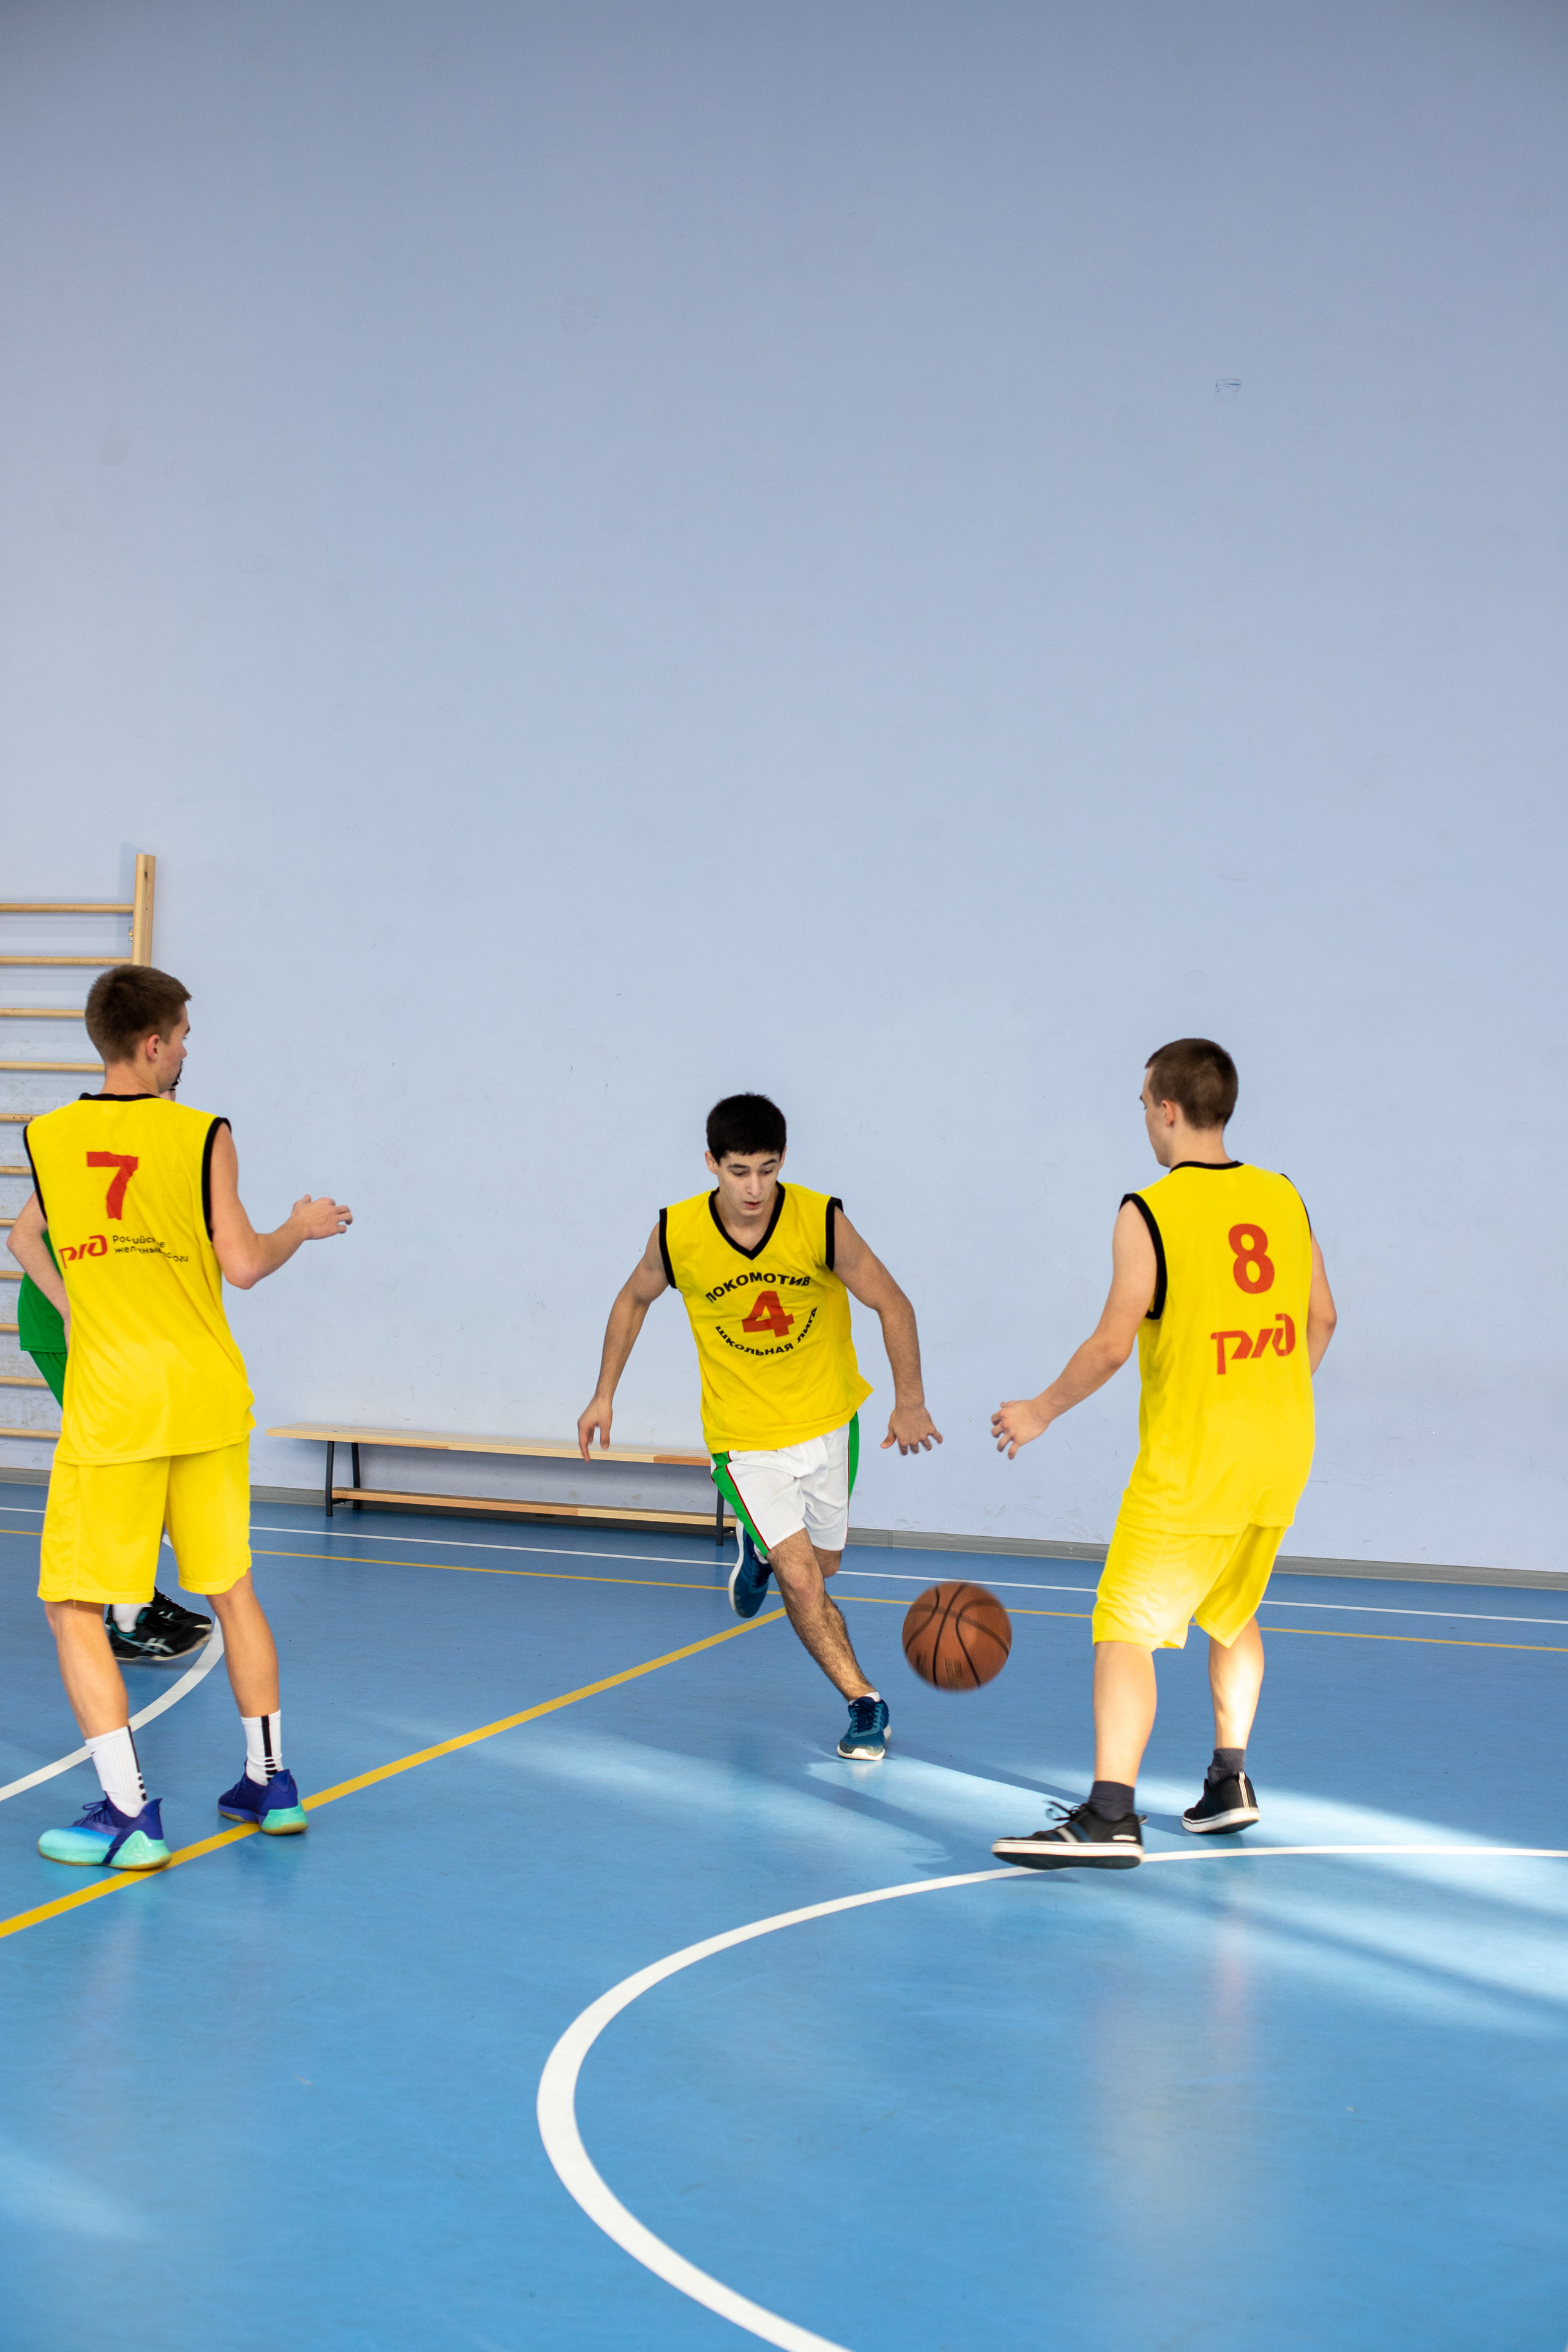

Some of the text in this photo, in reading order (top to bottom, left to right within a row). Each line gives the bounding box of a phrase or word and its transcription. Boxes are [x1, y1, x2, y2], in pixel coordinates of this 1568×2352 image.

[86, 1152, 138, 1220] 7
[1229, 1224, 1275, 1294] 8
[705, 1272, 811, 1303] ЛОКОМОТИВ
[715, 1306, 818, 1356] ШКОЛЬНАЯ ЛИГА
[742, 1291, 794, 1338] 4
